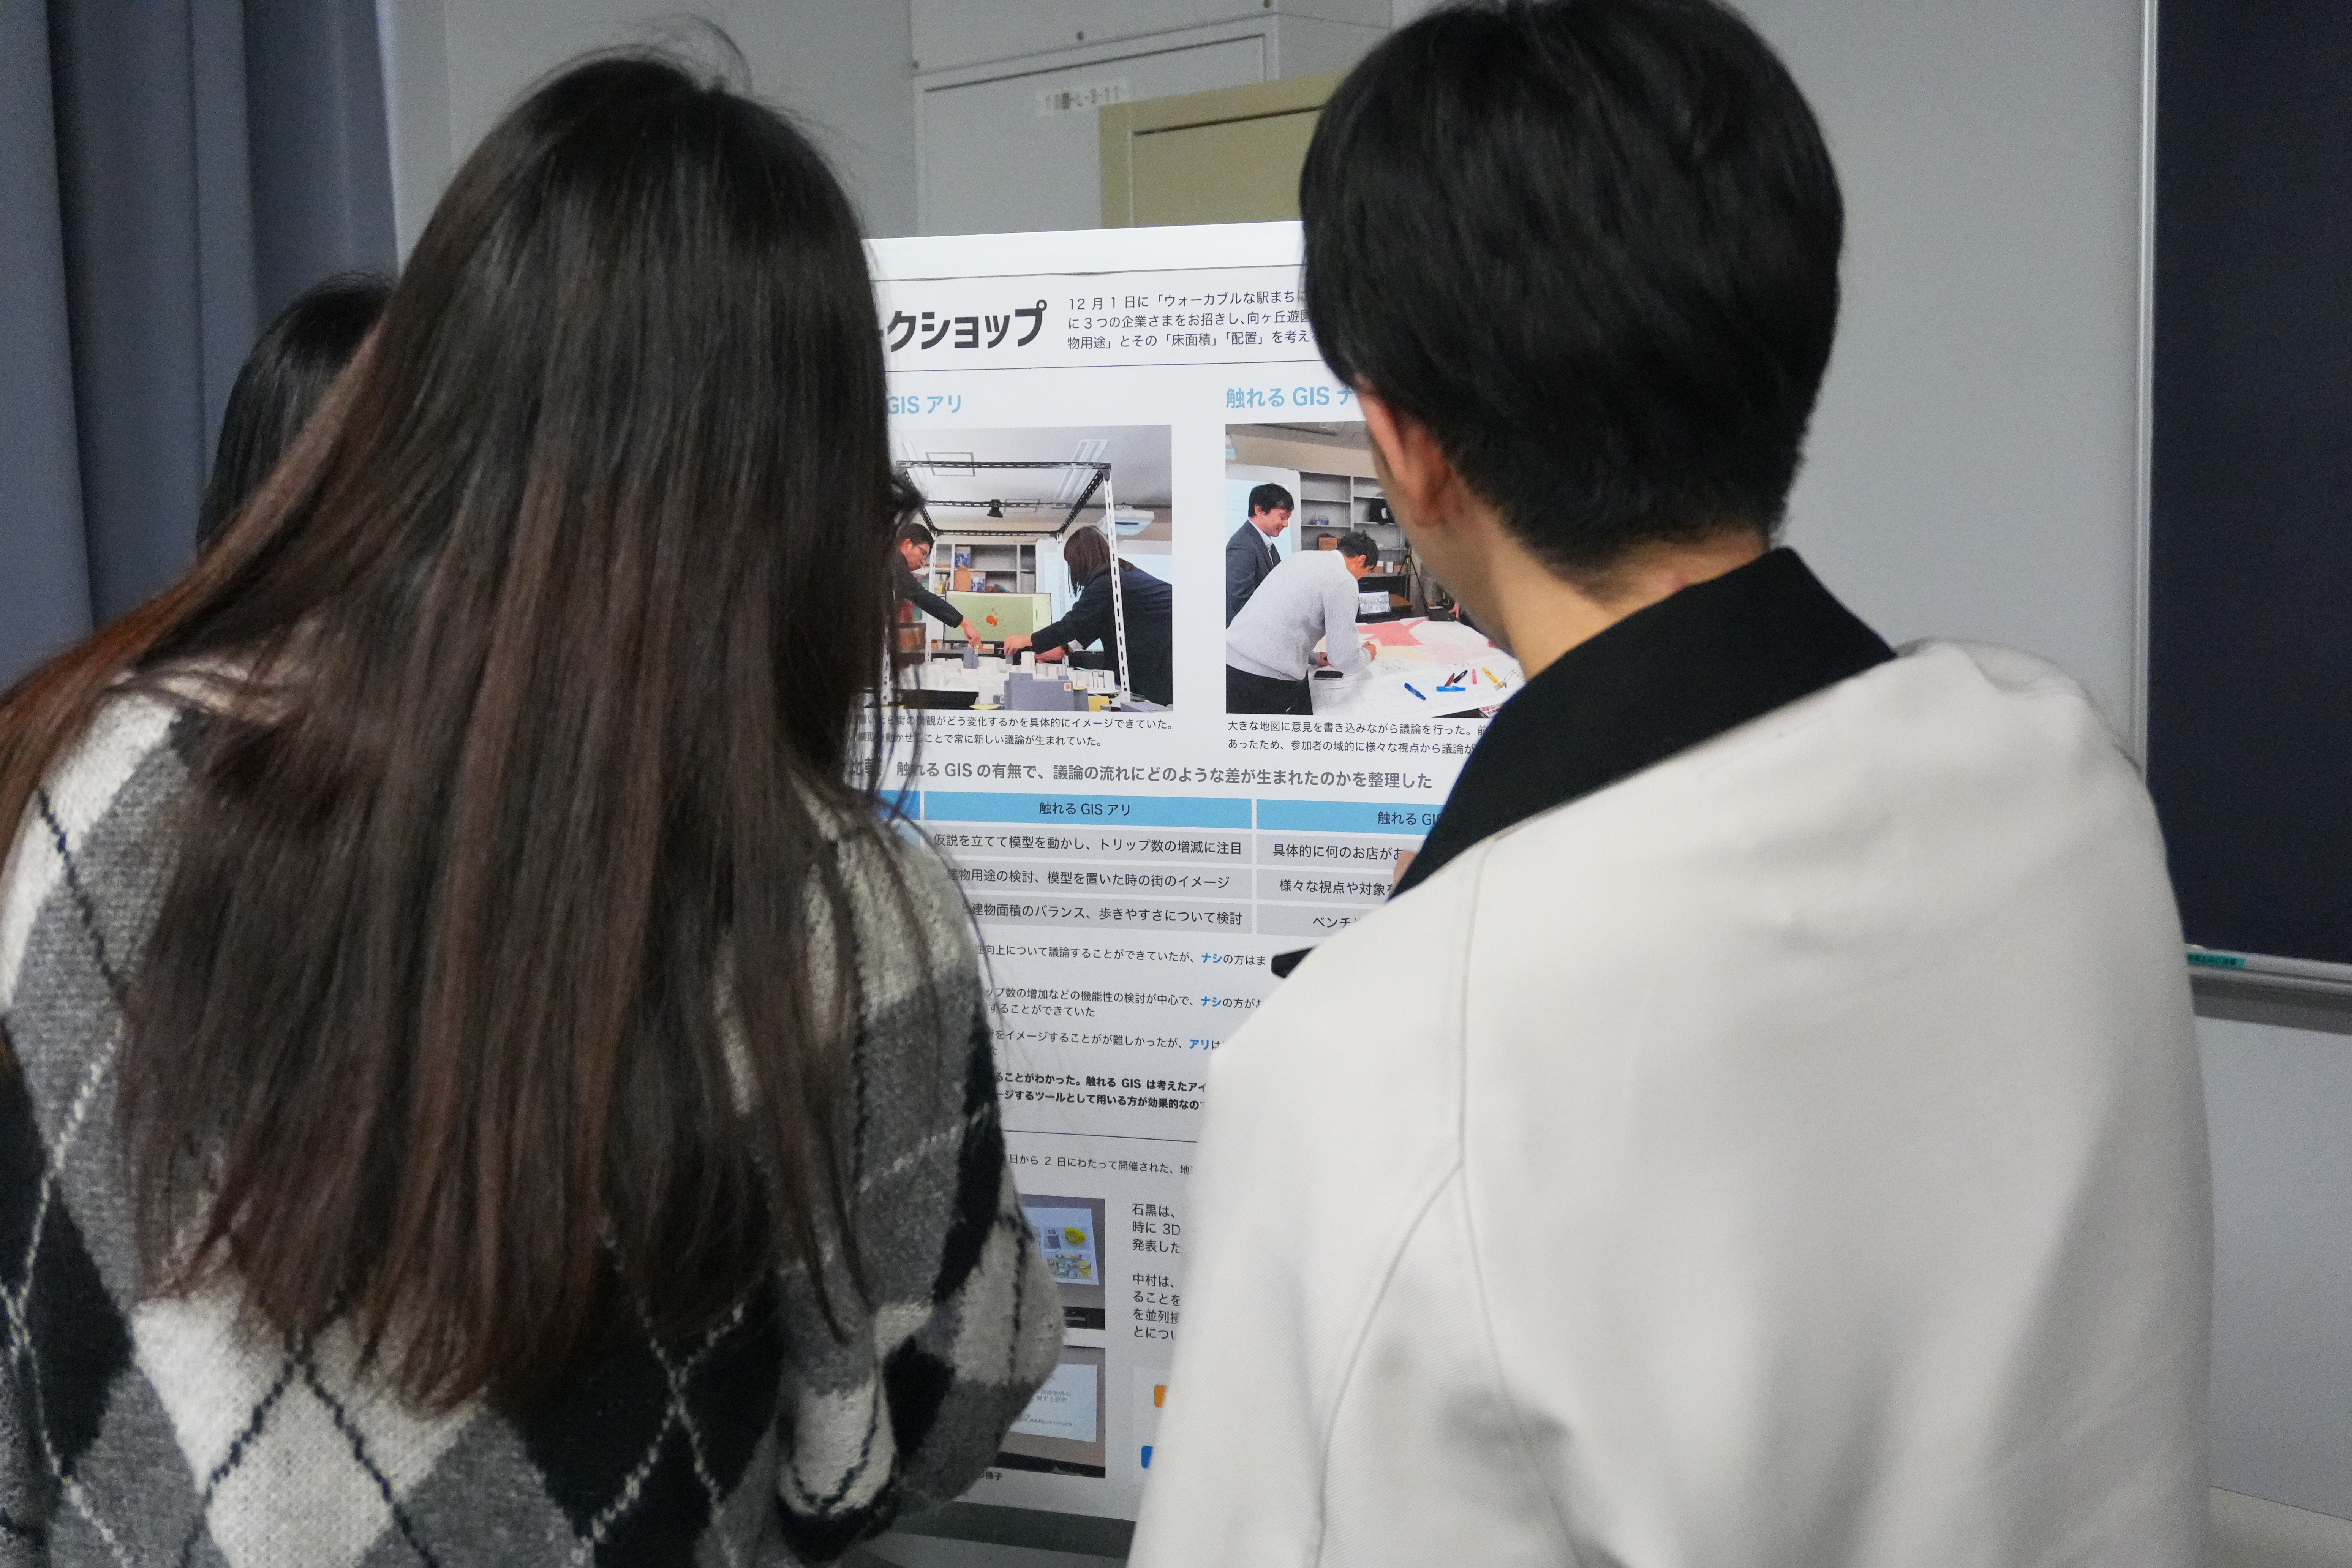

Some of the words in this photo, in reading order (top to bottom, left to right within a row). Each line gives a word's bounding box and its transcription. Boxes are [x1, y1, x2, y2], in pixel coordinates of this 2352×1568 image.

[879, 299, 1047, 352] クショップ
[1067, 330, 1316, 350] 物用途」とその「床面積」「配置」を考え
[1293, 386, 1329, 406] GIS
[1081, 803, 1103, 815] GIS
[963, 903, 1242, 925] 建物面積のバランス、歩きやすさについて検討
[1313, 917, 1358, 928] ベンチ
[991, 1029, 1224, 1050] をイメージすることがが難しかったが、アリは
[997, 1089, 1203, 1110] ージするツールとして用いる方が効果的なの
